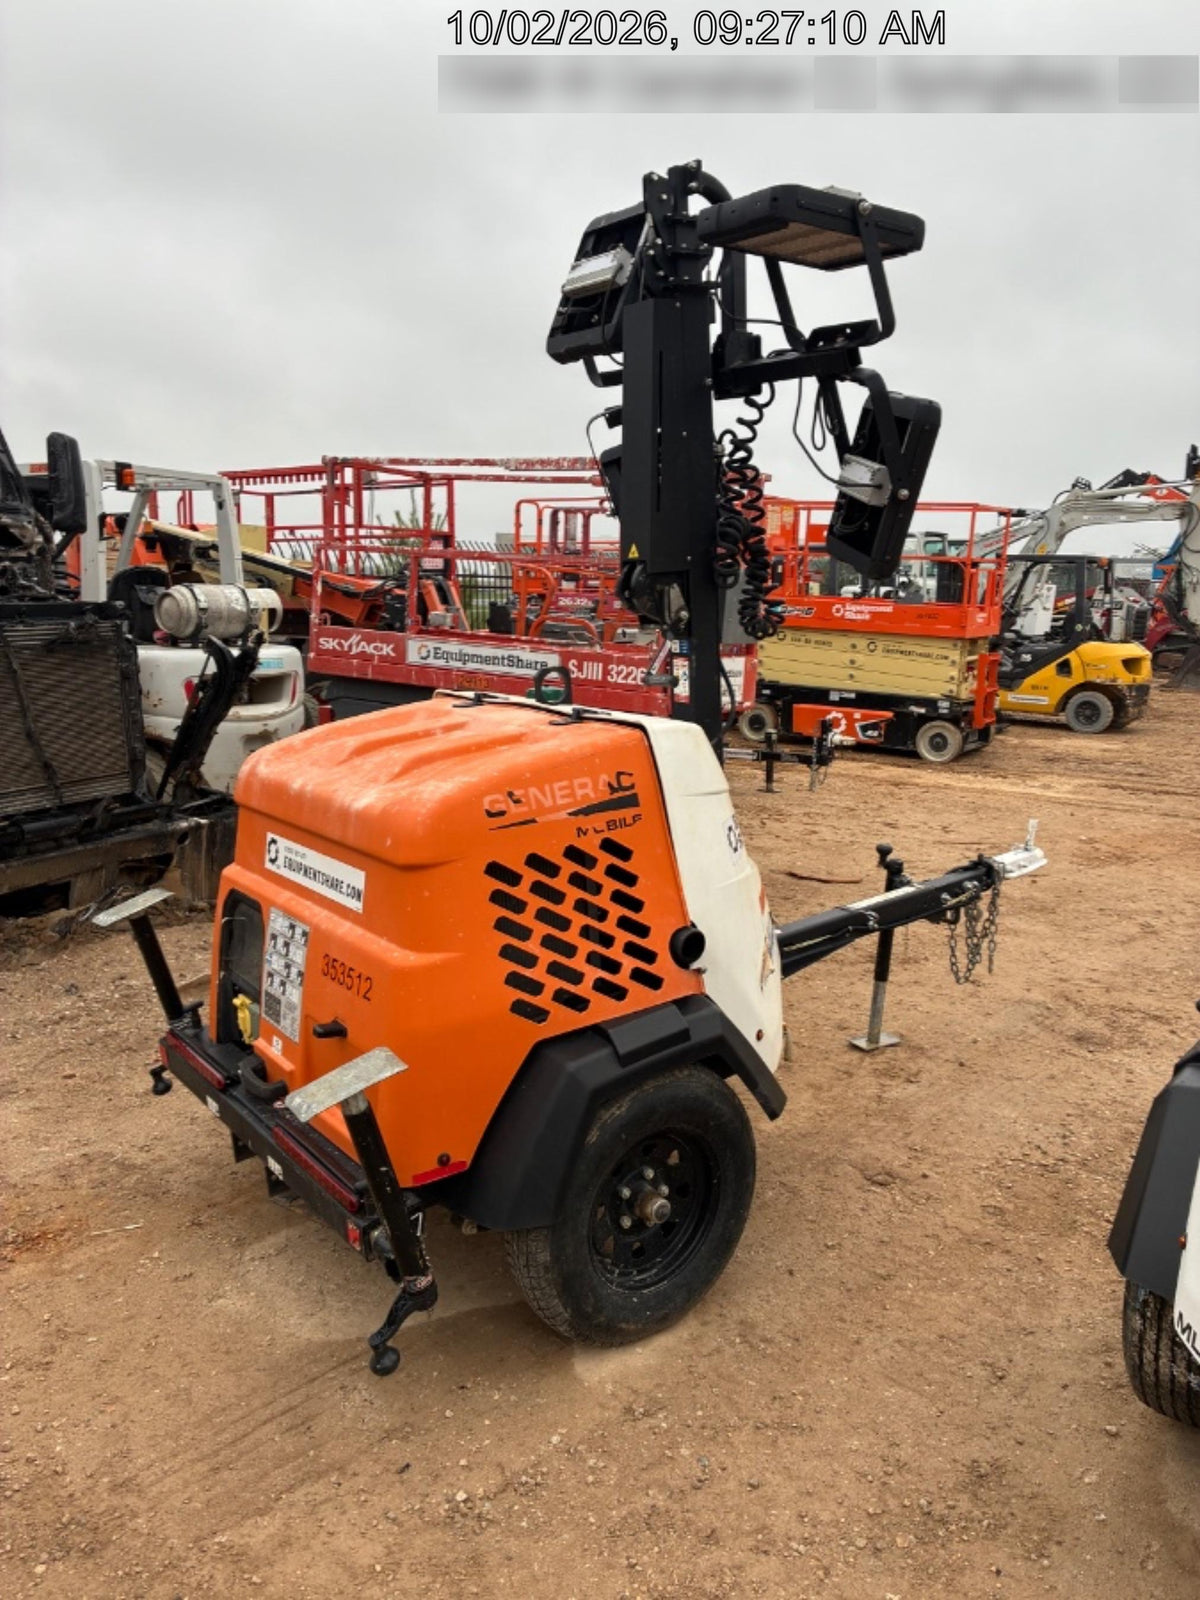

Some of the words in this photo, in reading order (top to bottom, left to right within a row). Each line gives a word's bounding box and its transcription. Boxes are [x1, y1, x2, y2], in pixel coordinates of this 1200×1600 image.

[318, 633, 397, 657] SKYJACK
[432, 646, 548, 670] EquipmentShare
[482, 770, 636, 818] GENERAC
[283, 855, 363, 903] EQUIPMENTSHARE.COM
[320, 953, 374, 1002] 353512
